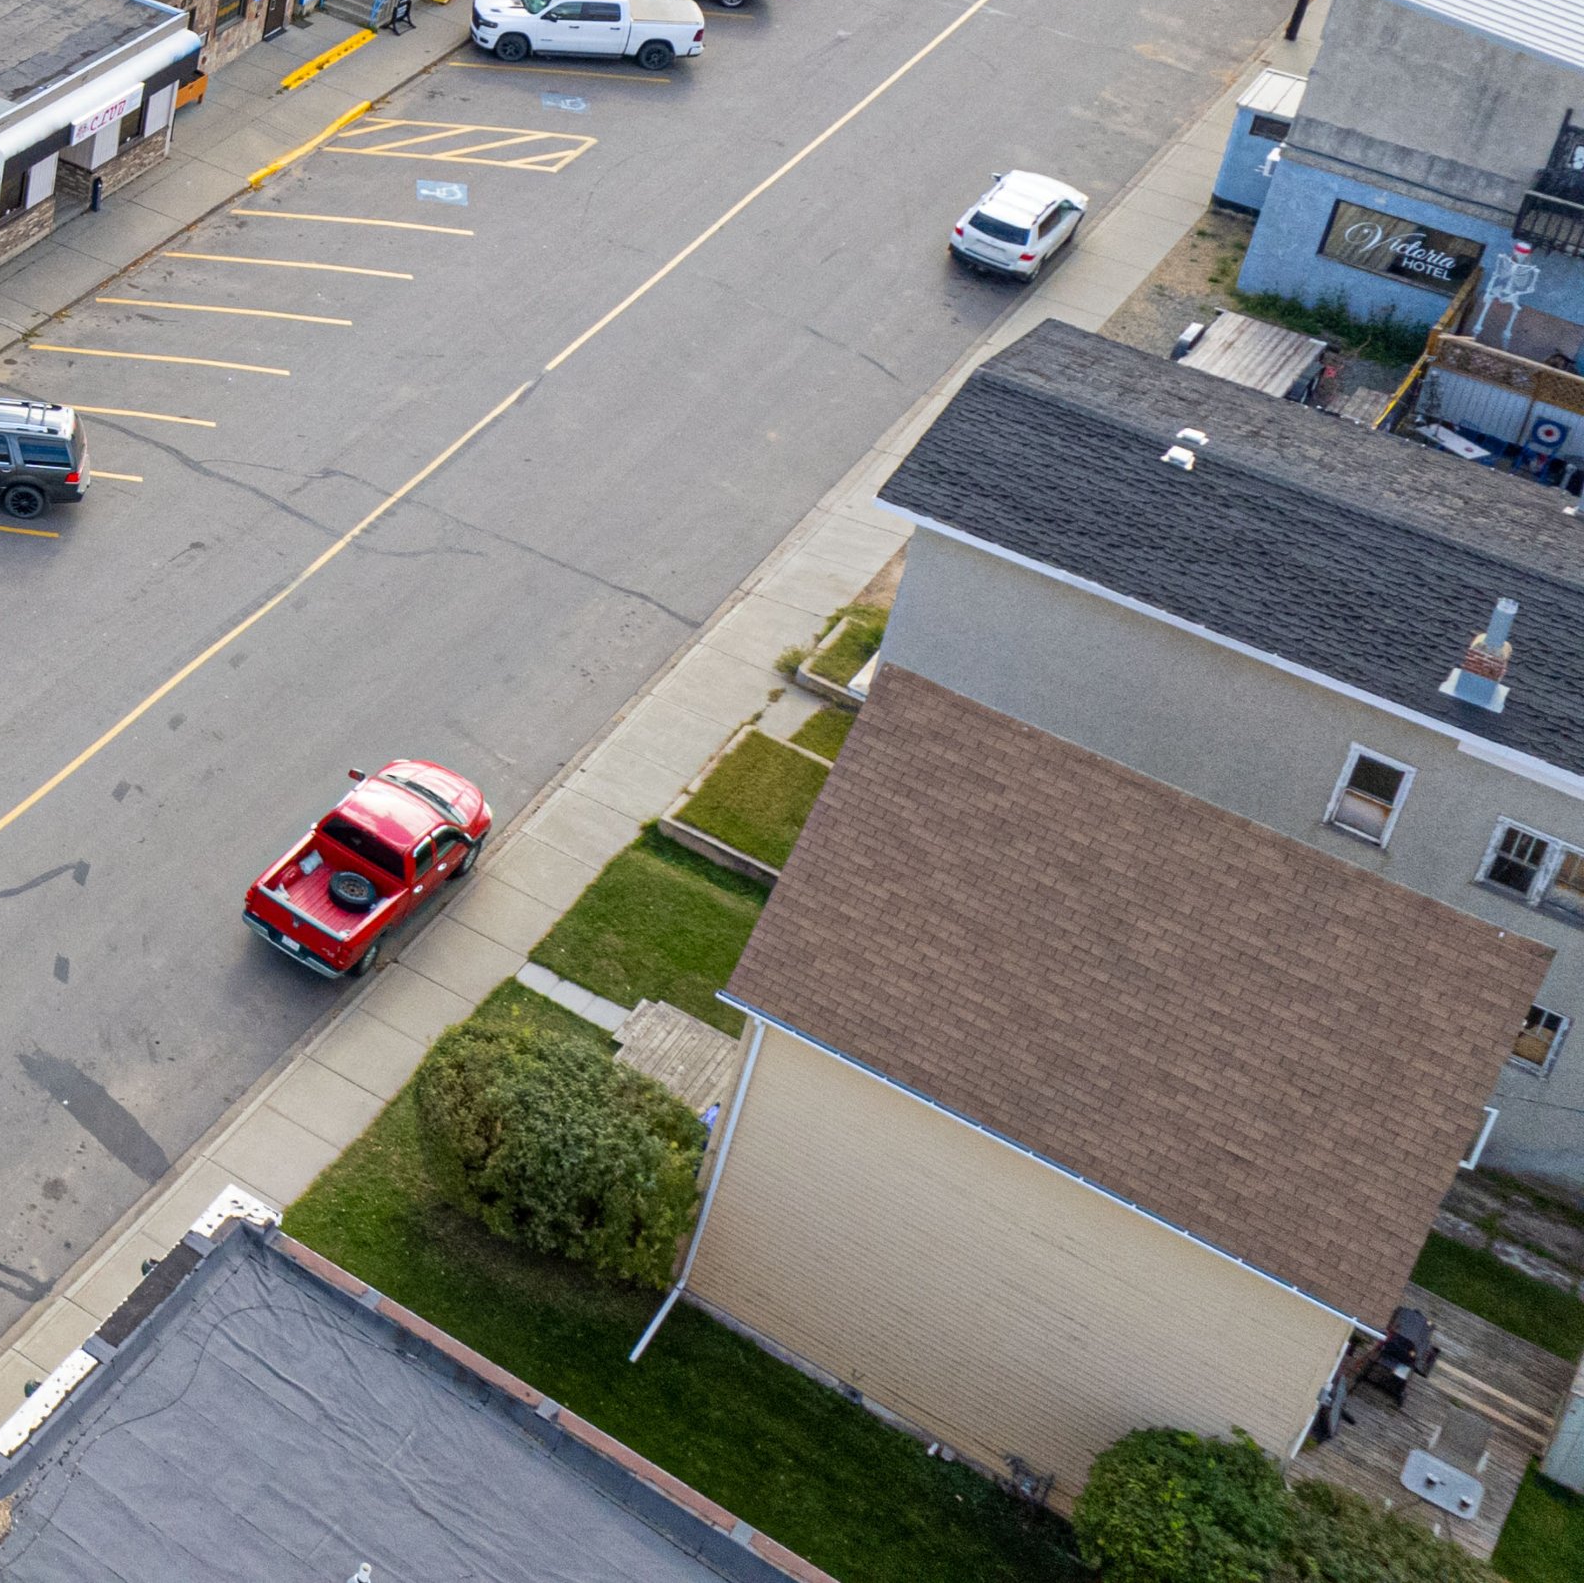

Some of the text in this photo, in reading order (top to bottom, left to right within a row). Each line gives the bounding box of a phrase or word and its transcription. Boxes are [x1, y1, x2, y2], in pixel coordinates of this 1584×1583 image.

[90, 100, 127, 131] CLUB
[1345, 221, 1456, 269] Victoria
[1401, 257, 1452, 281] HOTEL
